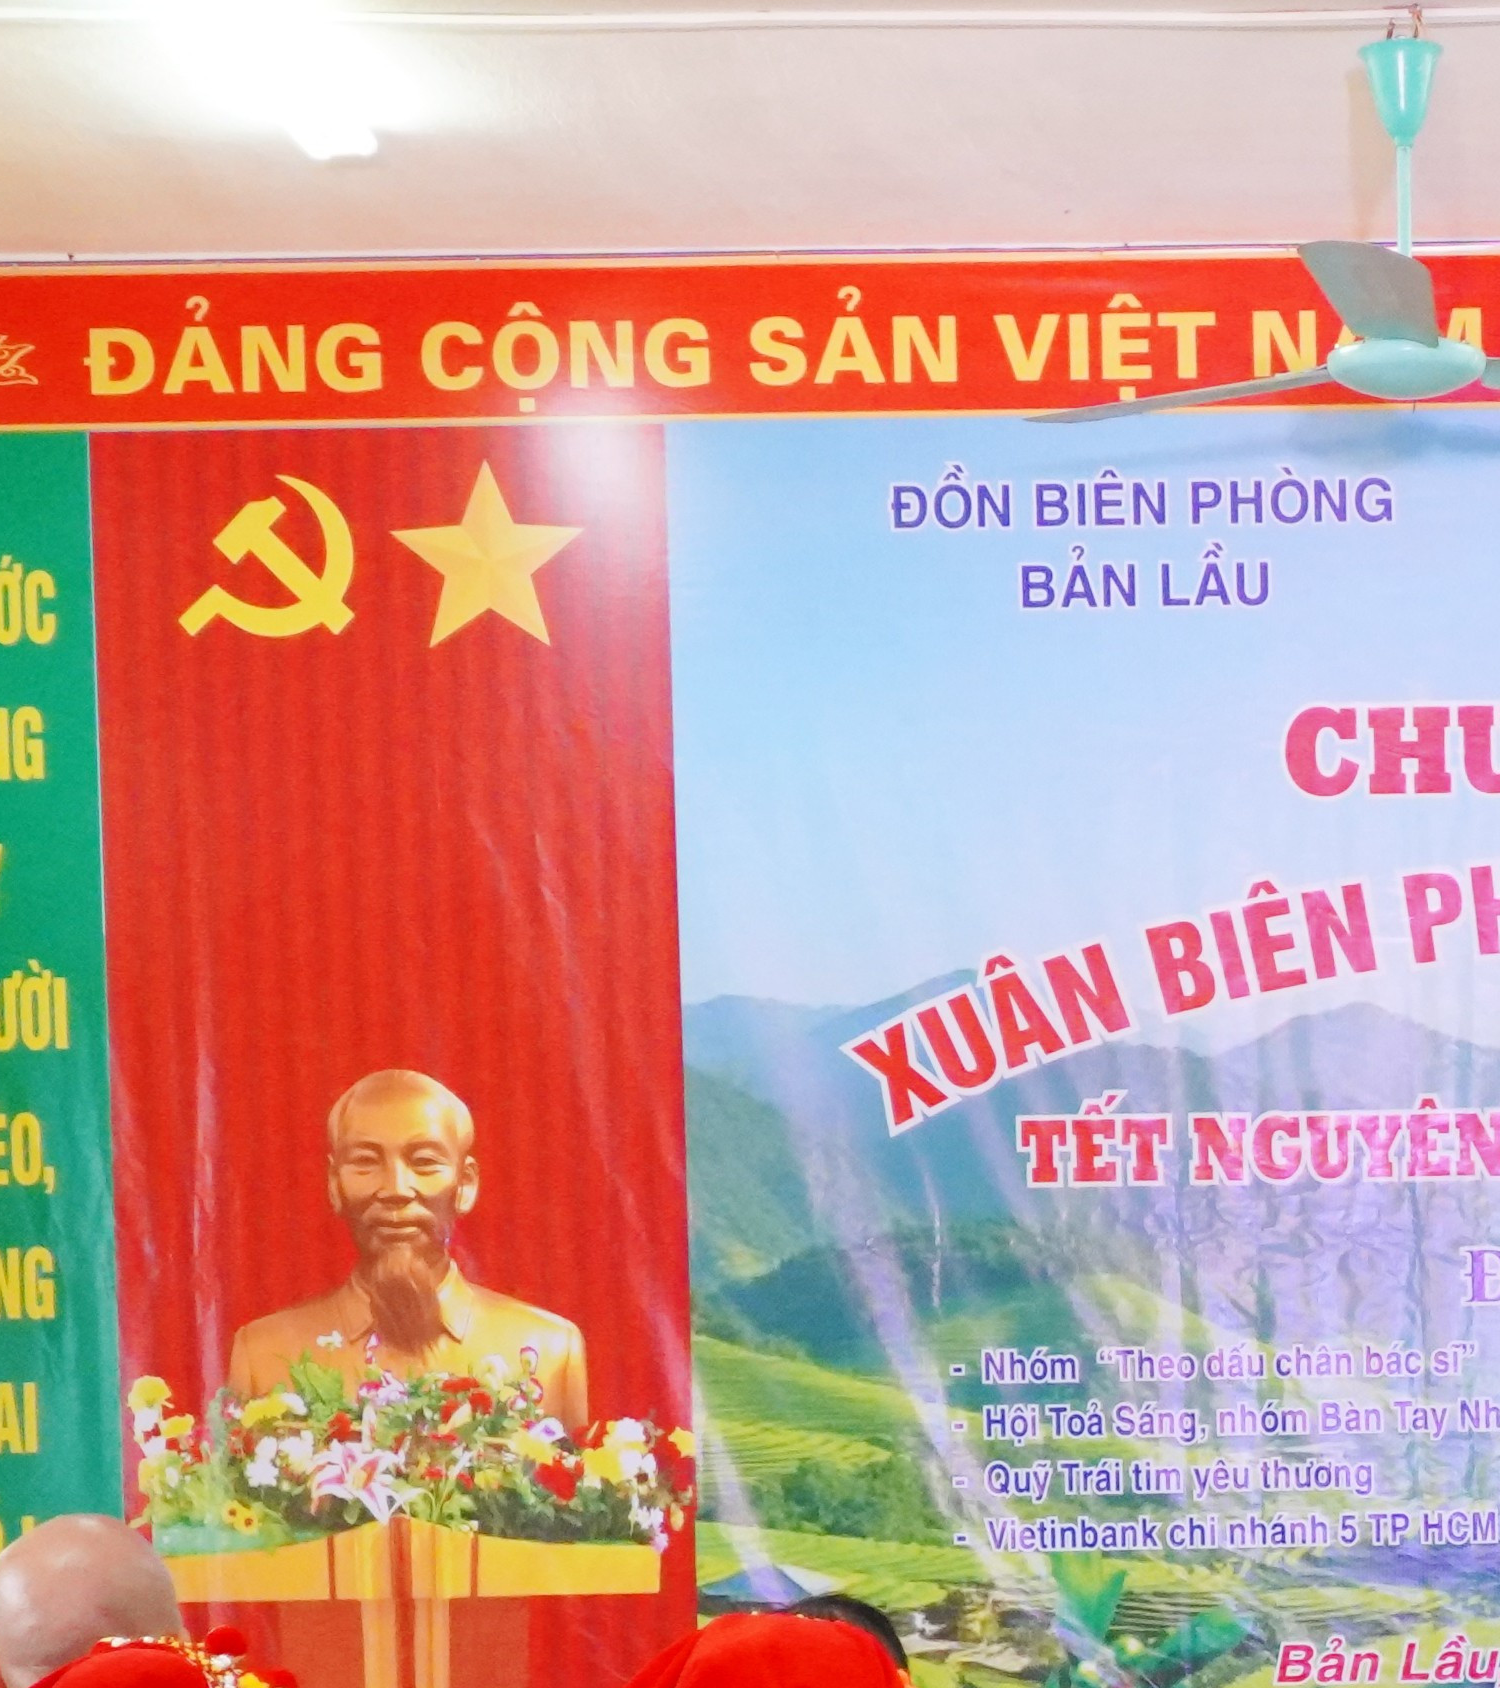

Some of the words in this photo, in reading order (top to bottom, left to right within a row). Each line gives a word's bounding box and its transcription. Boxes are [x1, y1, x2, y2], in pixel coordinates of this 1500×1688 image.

[84, 295, 383, 397] ĐẢNG
[421, 301, 711, 413] CỘNG
[749, 286, 958, 386] SẢN
[994, 293, 1216, 403] VIỆT
[891, 464, 1011, 529] ĐỒN
[1036, 469, 1166, 527] BIÊN
[1191, 466, 1394, 525] PHÒNG
[1021, 545, 1136, 609] BẢN
[1162, 542, 1270, 607] LẦU
[853, 942, 1131, 1127] XUÂN
[1145, 880, 1379, 1016] BIÊN
[1020, 1093, 1171, 1184] TẾT
[984, 1348, 1077, 1382] Nhóm
[1207, 1343, 1264, 1378] dấu
[1276, 1343, 1352, 1376] chân
[1365, 1343, 1423, 1376] bác
[986, 1404, 1037, 1444] Hội
[1050, 1402, 1104, 1436] Toả
[1115, 1403, 1207, 1442] Sáng,
[1219, 1403, 1309, 1435] nhóm
[1321, 1401, 1382, 1432] Bàn
[1395, 1400, 1447, 1438] Tay
[987, 1461, 1050, 1500] Quỹ
[1062, 1461, 1121, 1493] Trái
[1132, 1462, 1181, 1492] tim
[1194, 1460, 1249, 1498] yêu
[1261, 1458, 1373, 1493] thương
[988, 1517, 1161, 1550] Vietinbank
[1170, 1516, 1216, 1546] chi
[1229, 1515, 1328, 1546] nhánh
[1340, 1515, 1357, 1545] 5
[1368, 1513, 1410, 1543] TP
[1424, 1512, 1497, 1543] HCM
[1276, 1636, 1379, 1686] Bản
